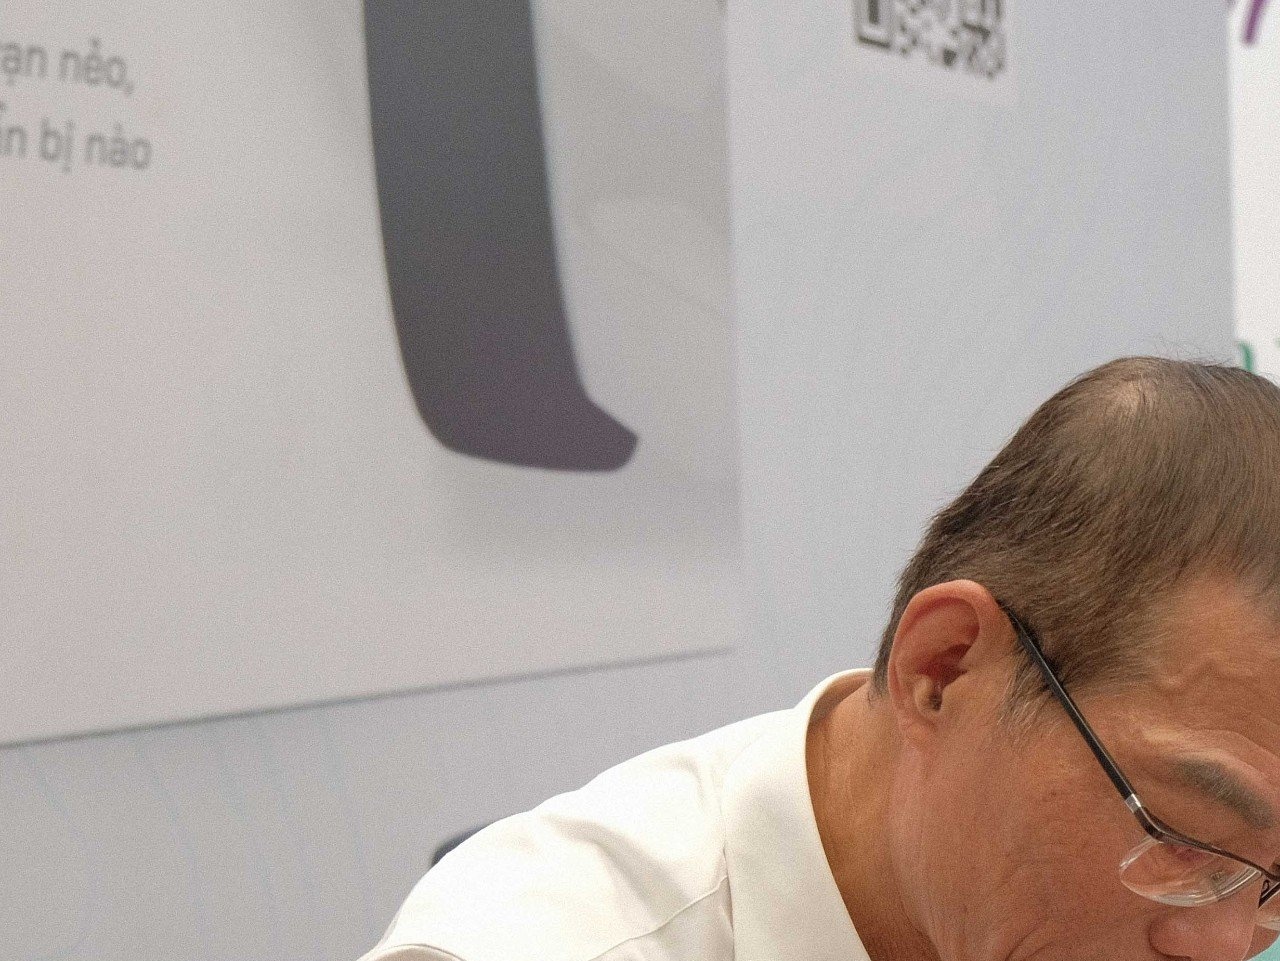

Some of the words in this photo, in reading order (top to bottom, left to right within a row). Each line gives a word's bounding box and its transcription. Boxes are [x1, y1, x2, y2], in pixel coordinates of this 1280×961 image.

[0, 41, 48, 87] ạn
[39, 117, 75, 174] bị
[85, 122, 151, 170] nào
